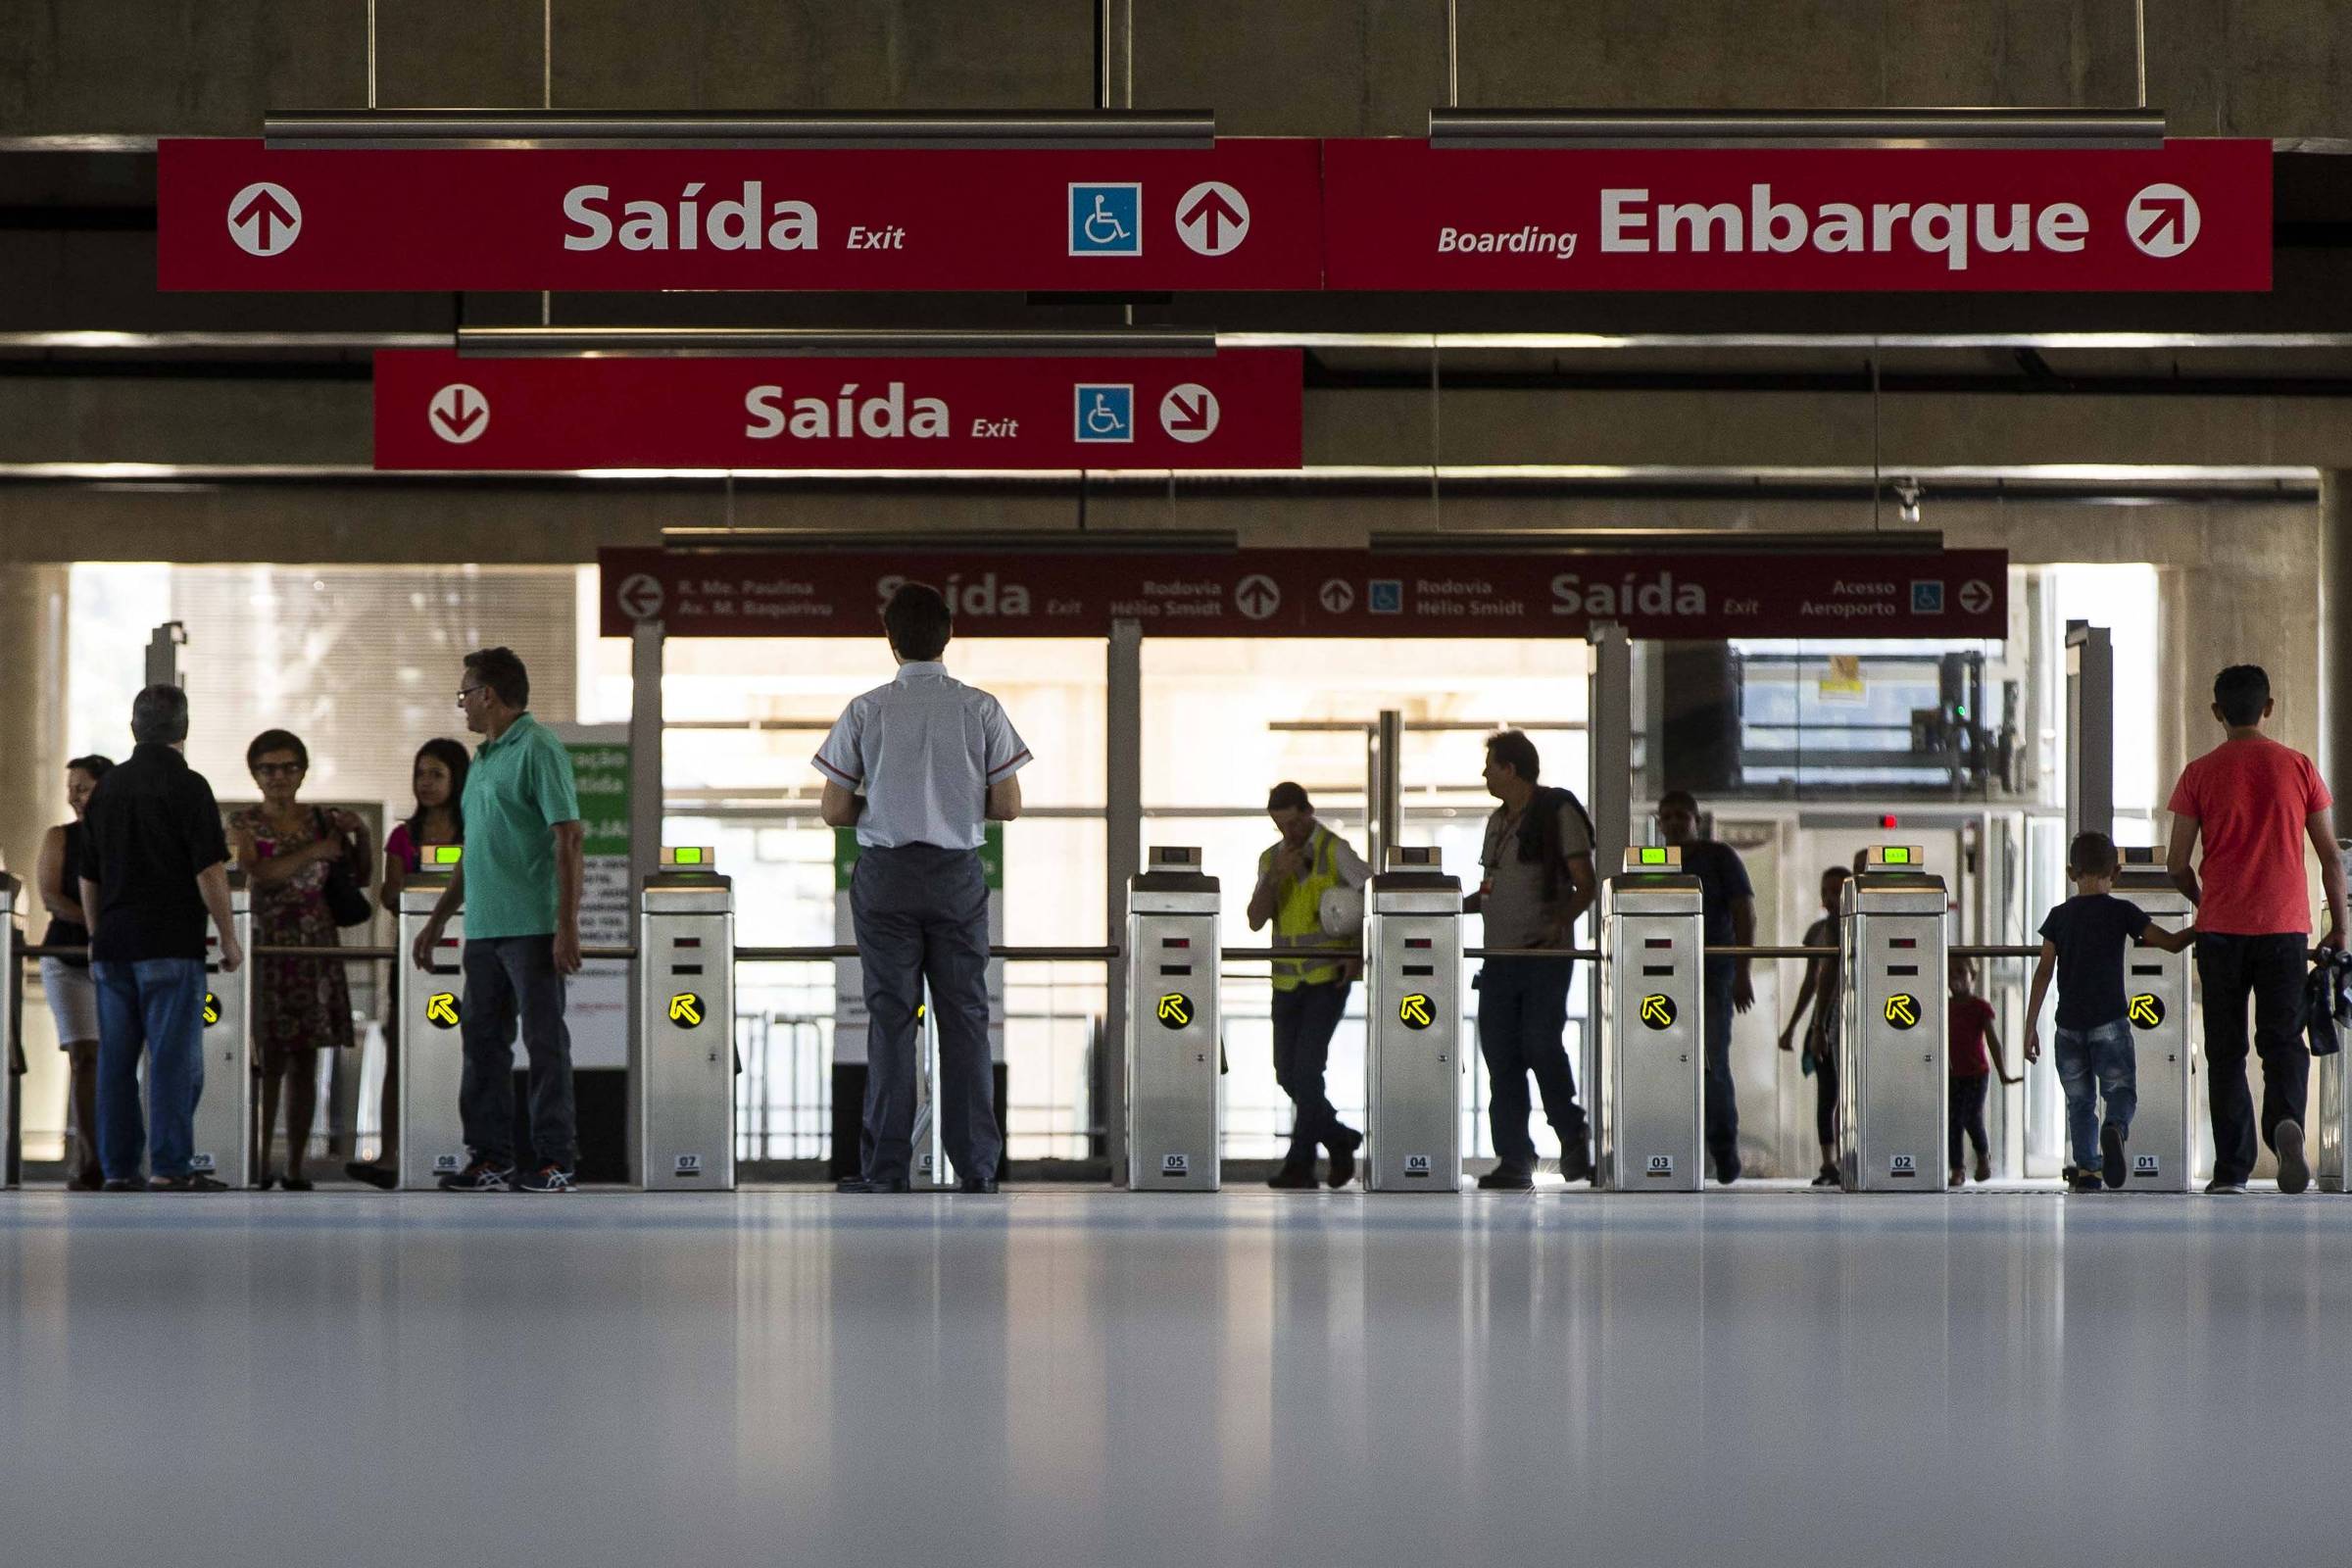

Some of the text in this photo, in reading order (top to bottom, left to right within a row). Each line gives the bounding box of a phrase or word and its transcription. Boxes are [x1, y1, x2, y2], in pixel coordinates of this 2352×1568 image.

[563, 180, 906, 252] Saída Exit
[1438, 183, 2090, 270] Boarding Embarque
[745, 381, 1019, 439] Saída Exit
[742, 580, 814, 595] Paulina
[876, 573, 1082, 616] Sída Exit
[1143, 580, 1222, 596] Rodovia
[1416, 580, 1492, 595] Rodovia
[1550, 571, 1758, 615] Saída Exit
[1833, 580, 1896, 595] Acesso
[1165, 601, 1222, 615] Smidt
[1469, 601, 1524, 615] Smidt
[1800, 601, 1896, 619] Aeroporto
[679, 1155, 697, 1166] 07
[1166, 1155, 1185, 1166] 05
[1409, 1156, 1427, 1167] 04
[1651, 1156, 1669, 1167] 03
[1894, 1156, 1912, 1167] 02
[2138, 1156, 2154, 1167] 01
